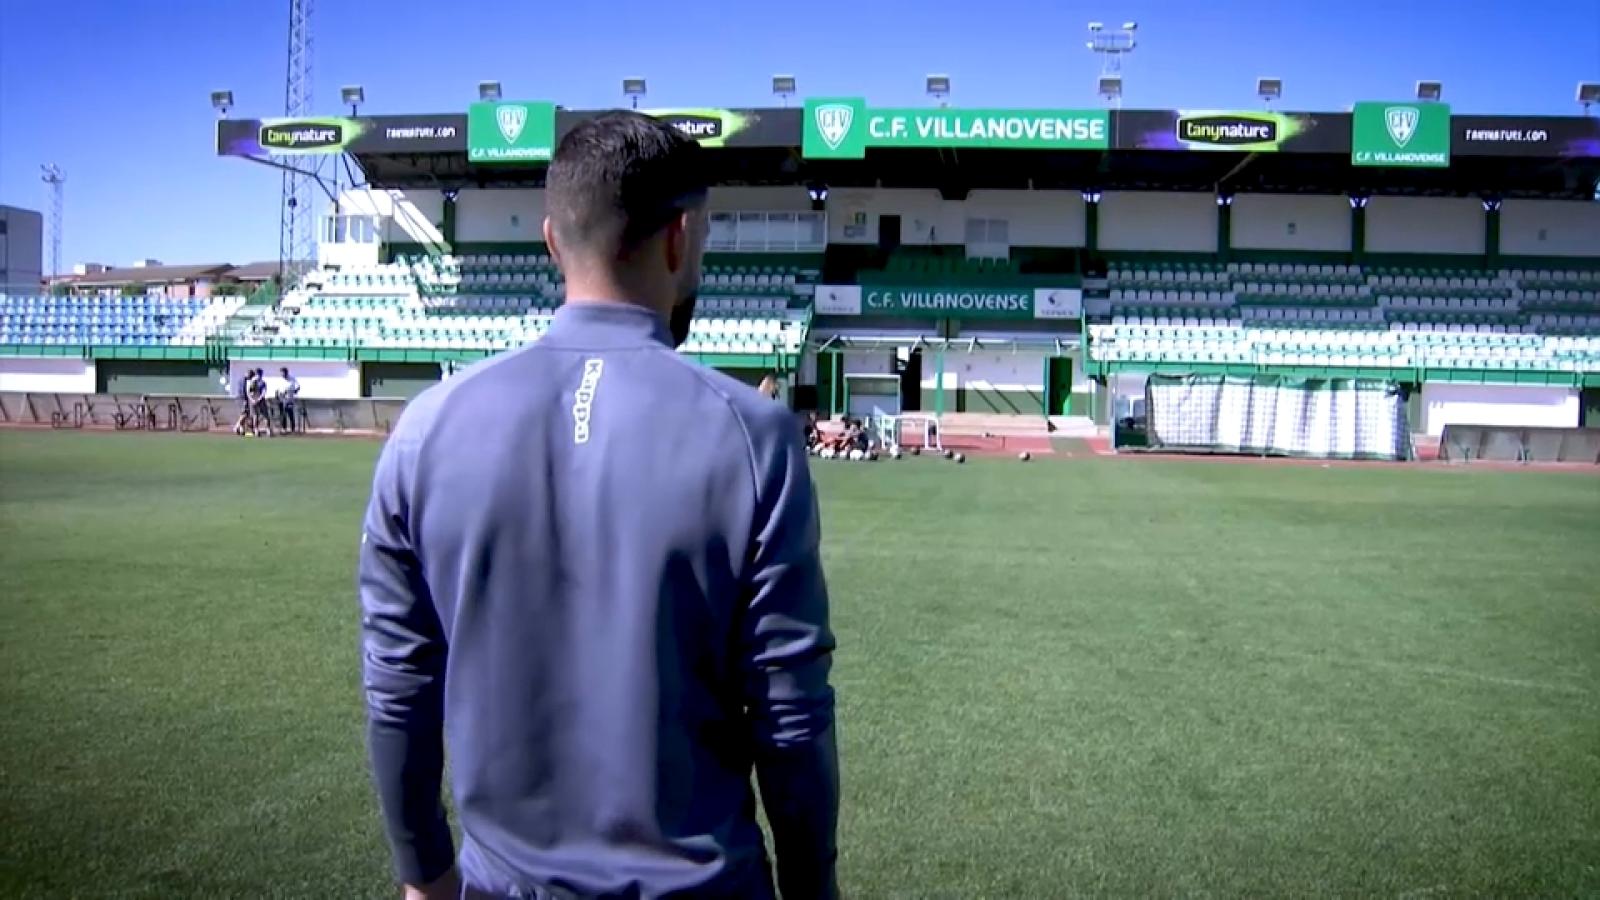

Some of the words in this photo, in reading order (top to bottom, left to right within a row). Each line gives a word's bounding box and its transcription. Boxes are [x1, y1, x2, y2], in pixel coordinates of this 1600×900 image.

[268, 129, 336, 146] tanynature
[869, 117, 908, 138] C.F.
[916, 117, 1105, 140] VILLANOVENSE
[1187, 121, 1269, 141] tanynature
[488, 147, 551, 158] VILLANOVENSE
[1374, 152, 1445, 163] VILLANOVENSE
[868, 291, 894, 308] C.F.
[901, 291, 1029, 311] VILLANOVENSE
